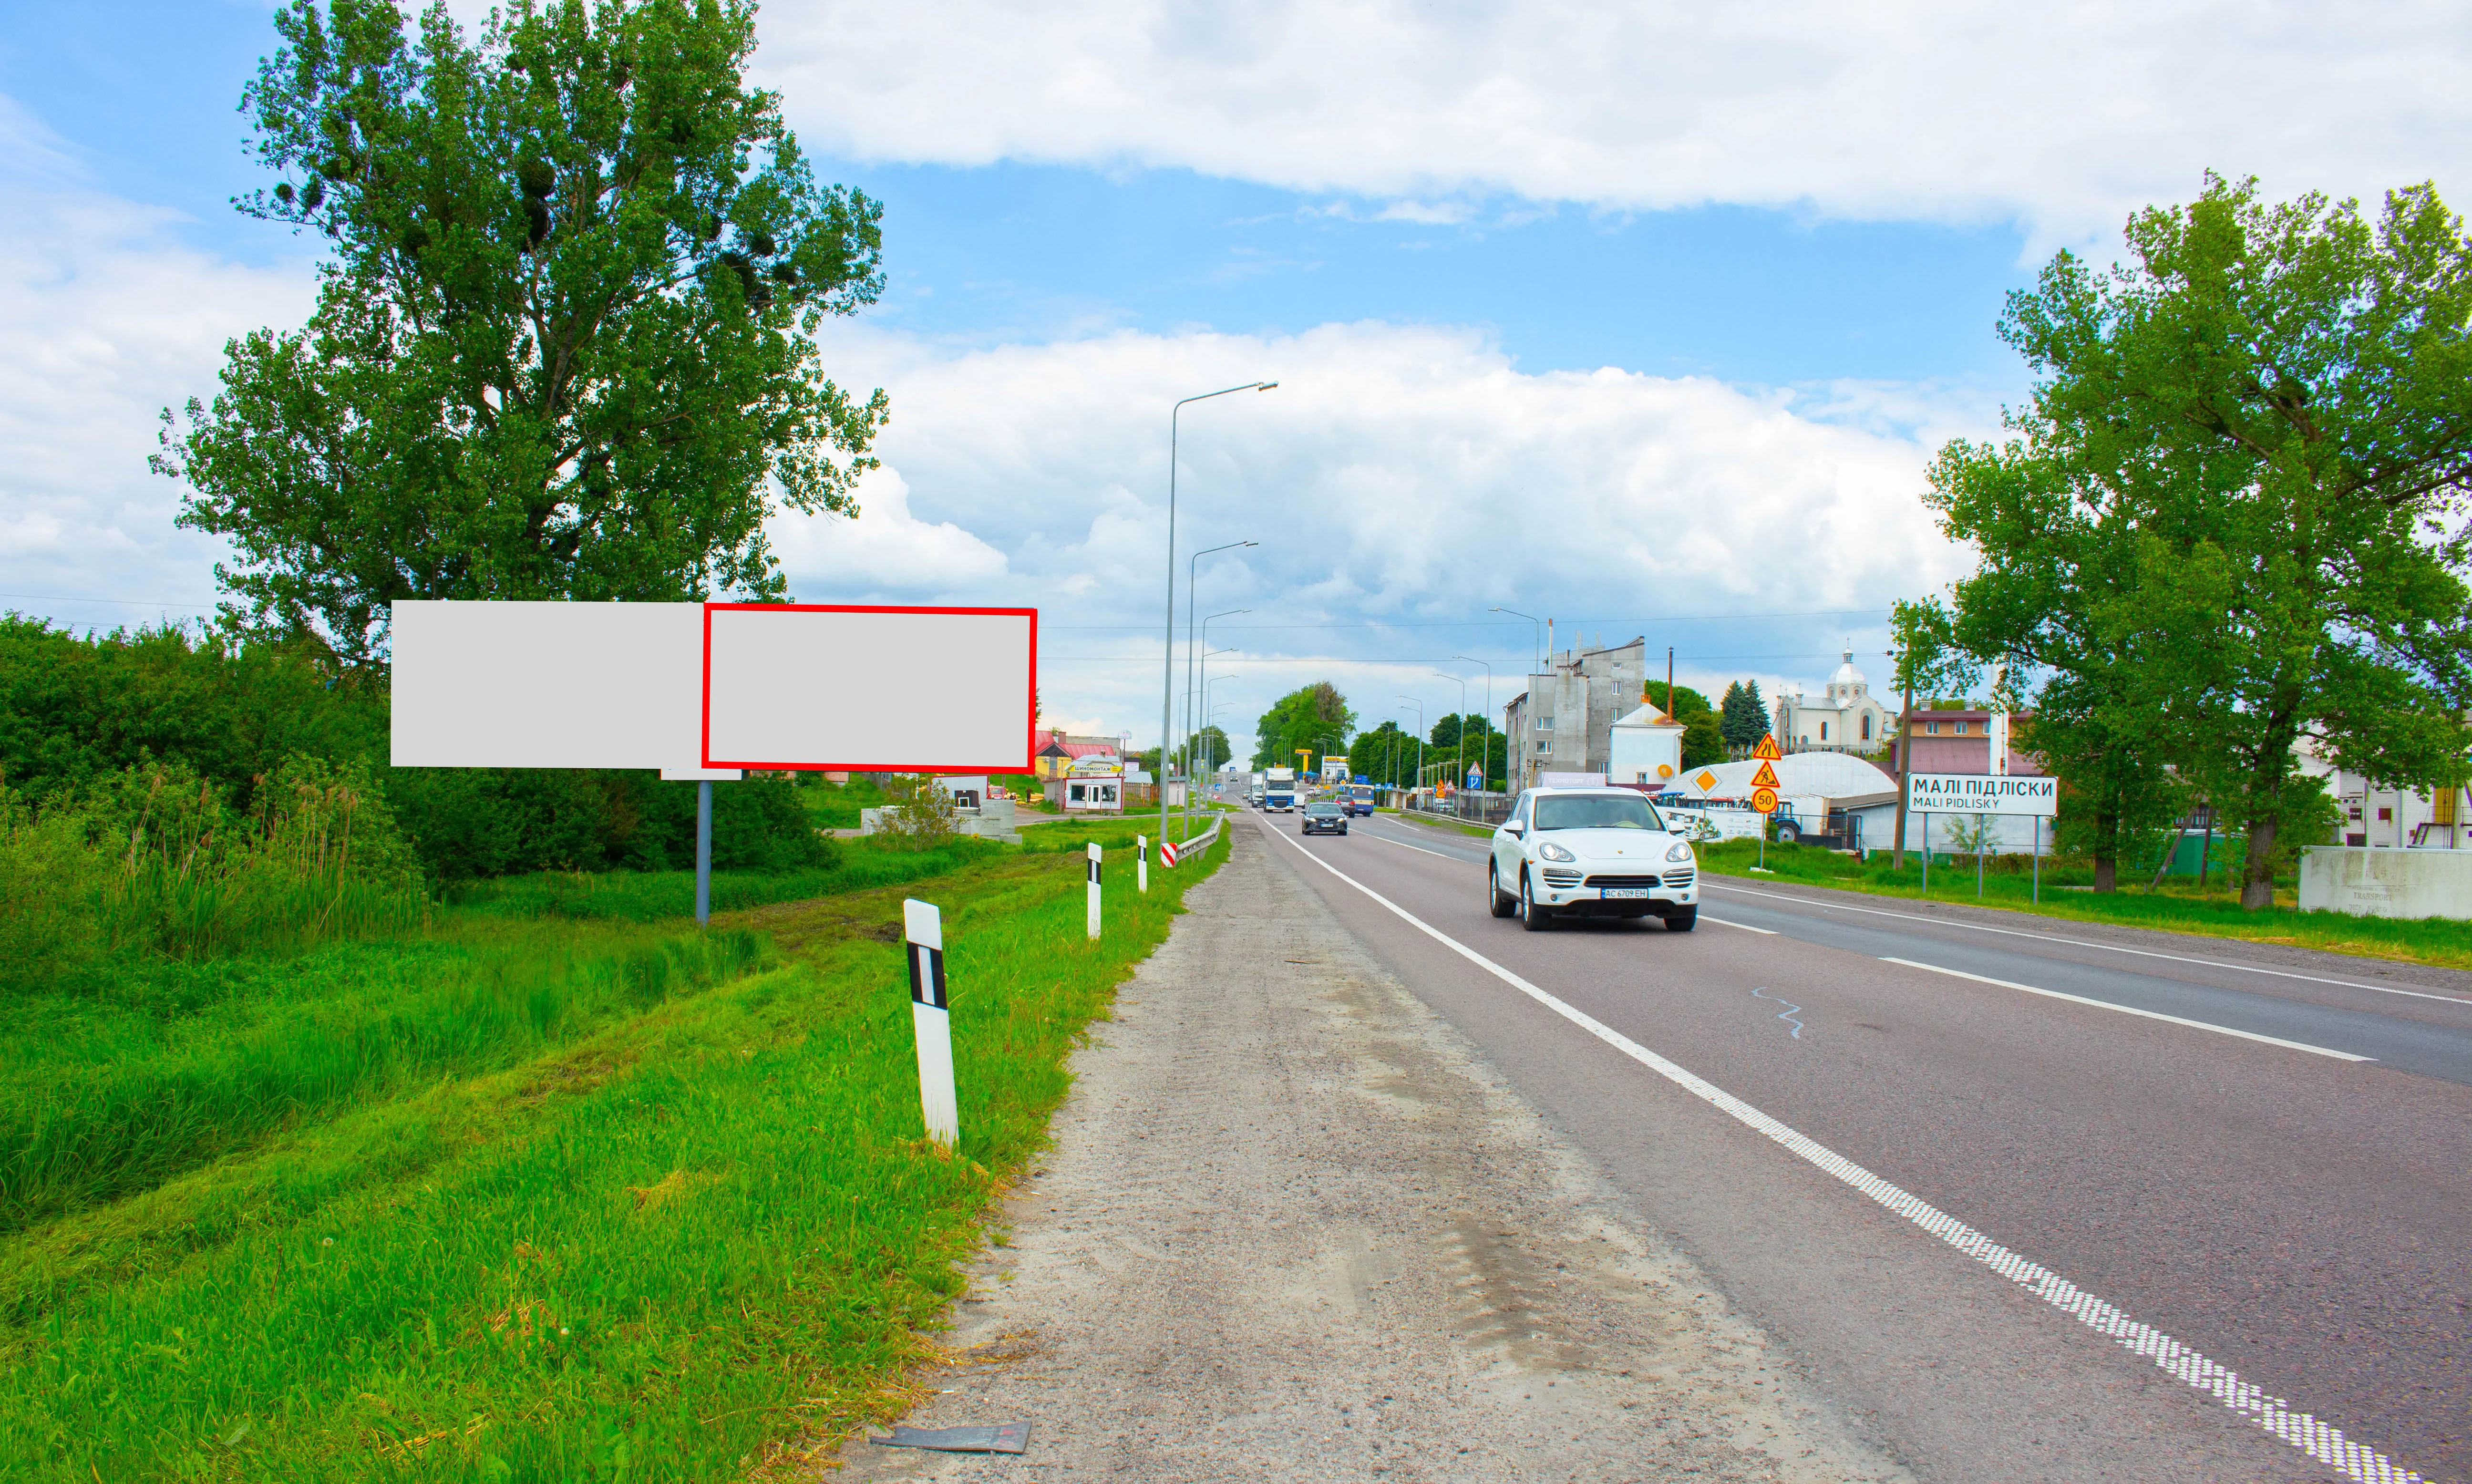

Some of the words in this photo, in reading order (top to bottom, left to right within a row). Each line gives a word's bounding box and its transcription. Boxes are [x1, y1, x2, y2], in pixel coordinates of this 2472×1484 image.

[1914, 779, 1960, 794] МАЛІ
[1966, 780, 2052, 797] ПІДЛІСКИ
[1759, 795, 1772, 805] 50
[1913, 797, 1942, 807] MALI
[1946, 798, 1999, 809] PIDLISKY
[2353, 892, 2393, 902] TRANSPORT
